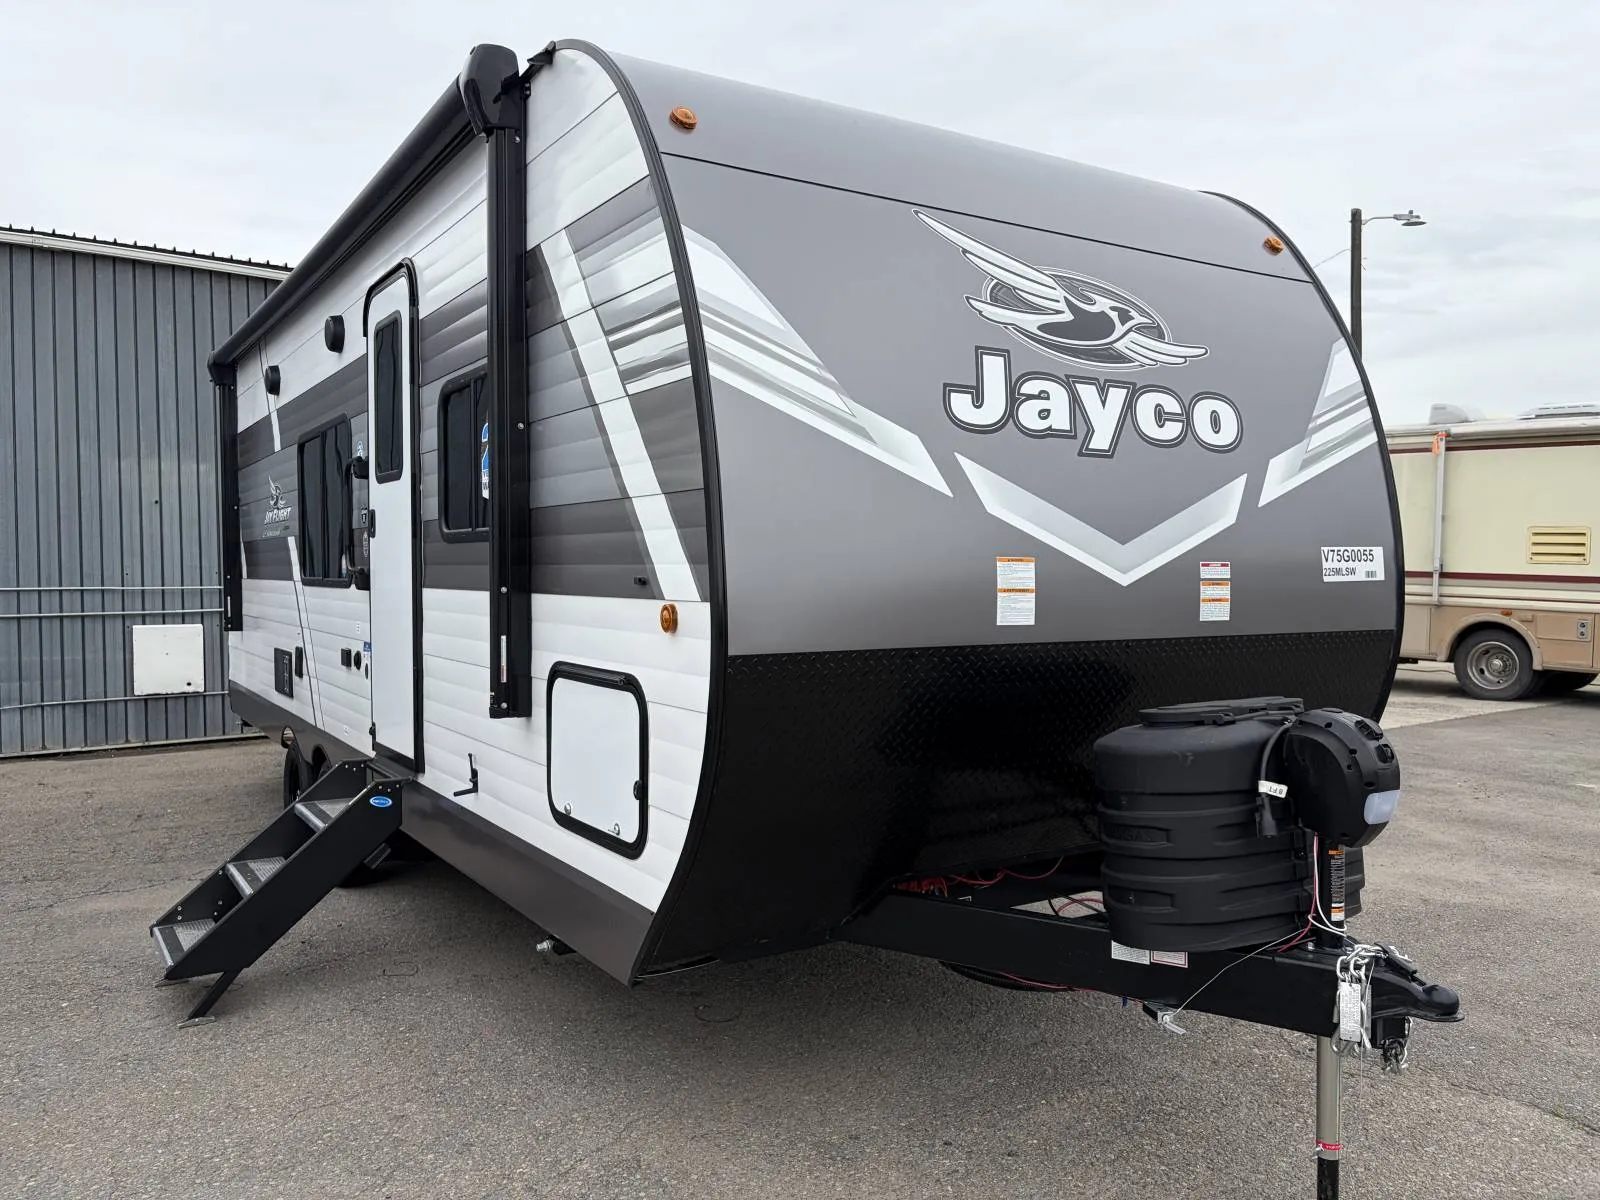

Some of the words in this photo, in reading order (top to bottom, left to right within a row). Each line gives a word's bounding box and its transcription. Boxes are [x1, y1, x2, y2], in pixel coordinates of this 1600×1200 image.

[943, 345, 1243, 459] Jayco
[1322, 549, 1374, 562] V75G0055
[1323, 567, 1357, 577] 225MLSW
